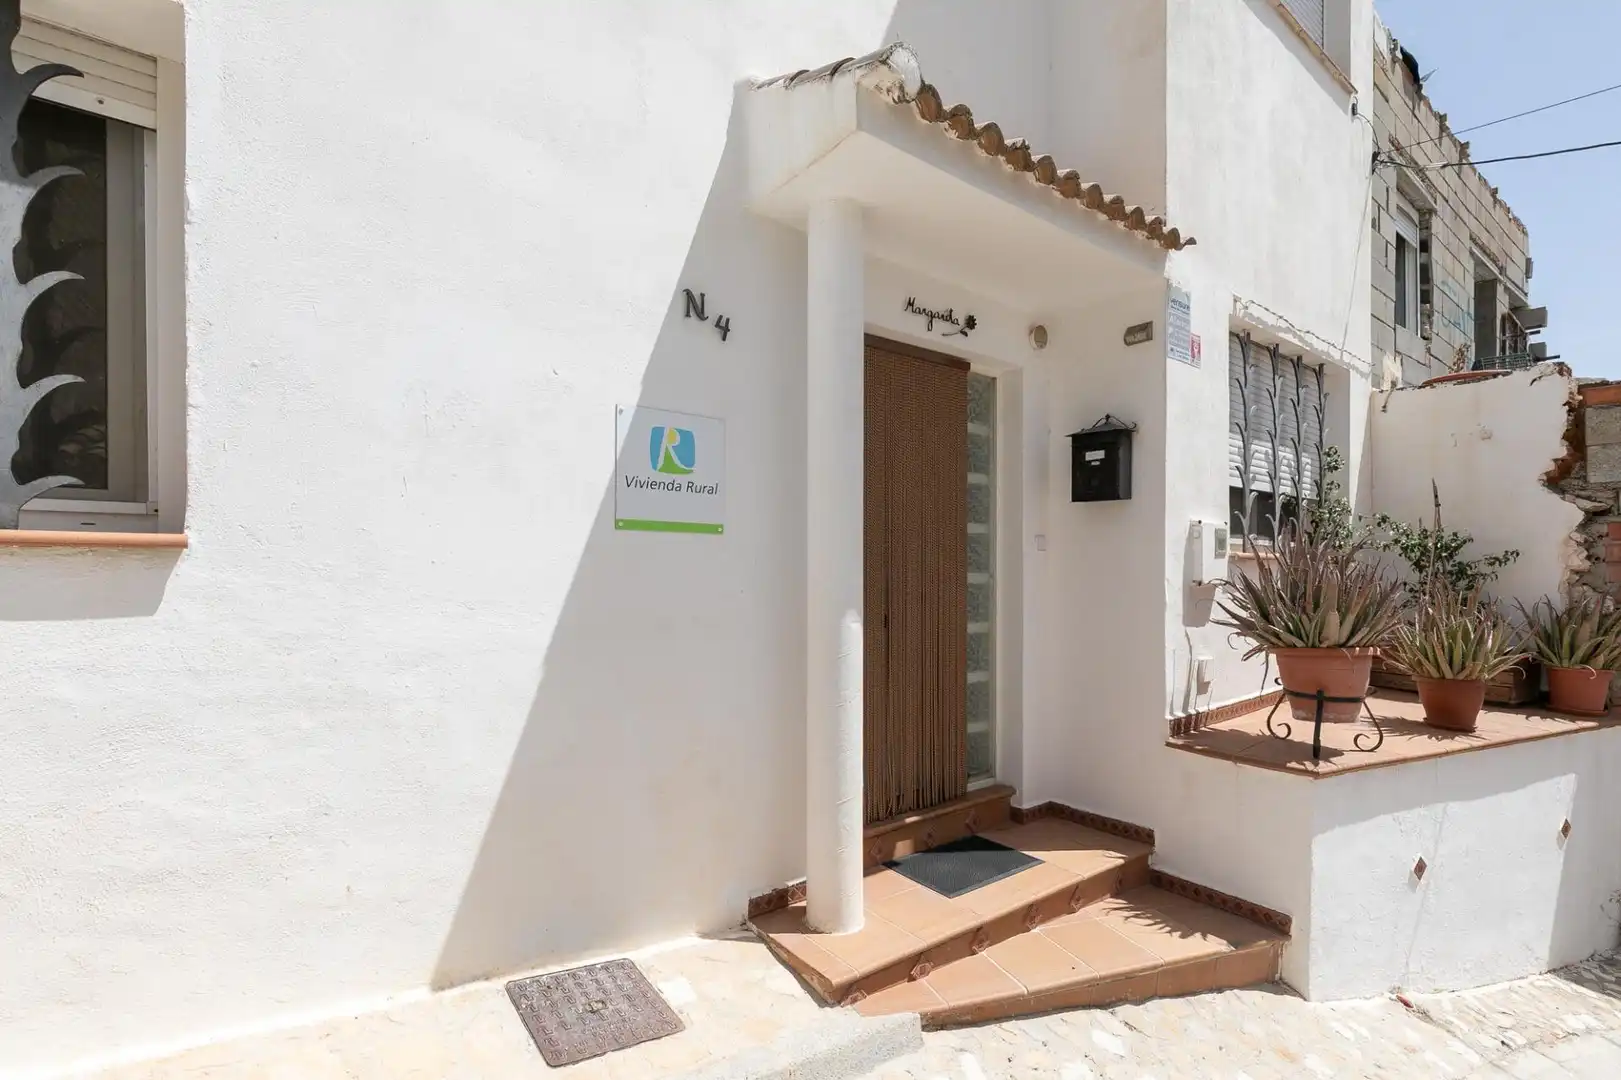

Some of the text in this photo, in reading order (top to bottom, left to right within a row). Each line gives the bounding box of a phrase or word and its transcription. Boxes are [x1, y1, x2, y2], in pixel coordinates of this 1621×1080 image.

[682, 288, 731, 342] N 4
[903, 296, 961, 332] Margarita
[625, 474, 719, 496] Vivienda Rural
